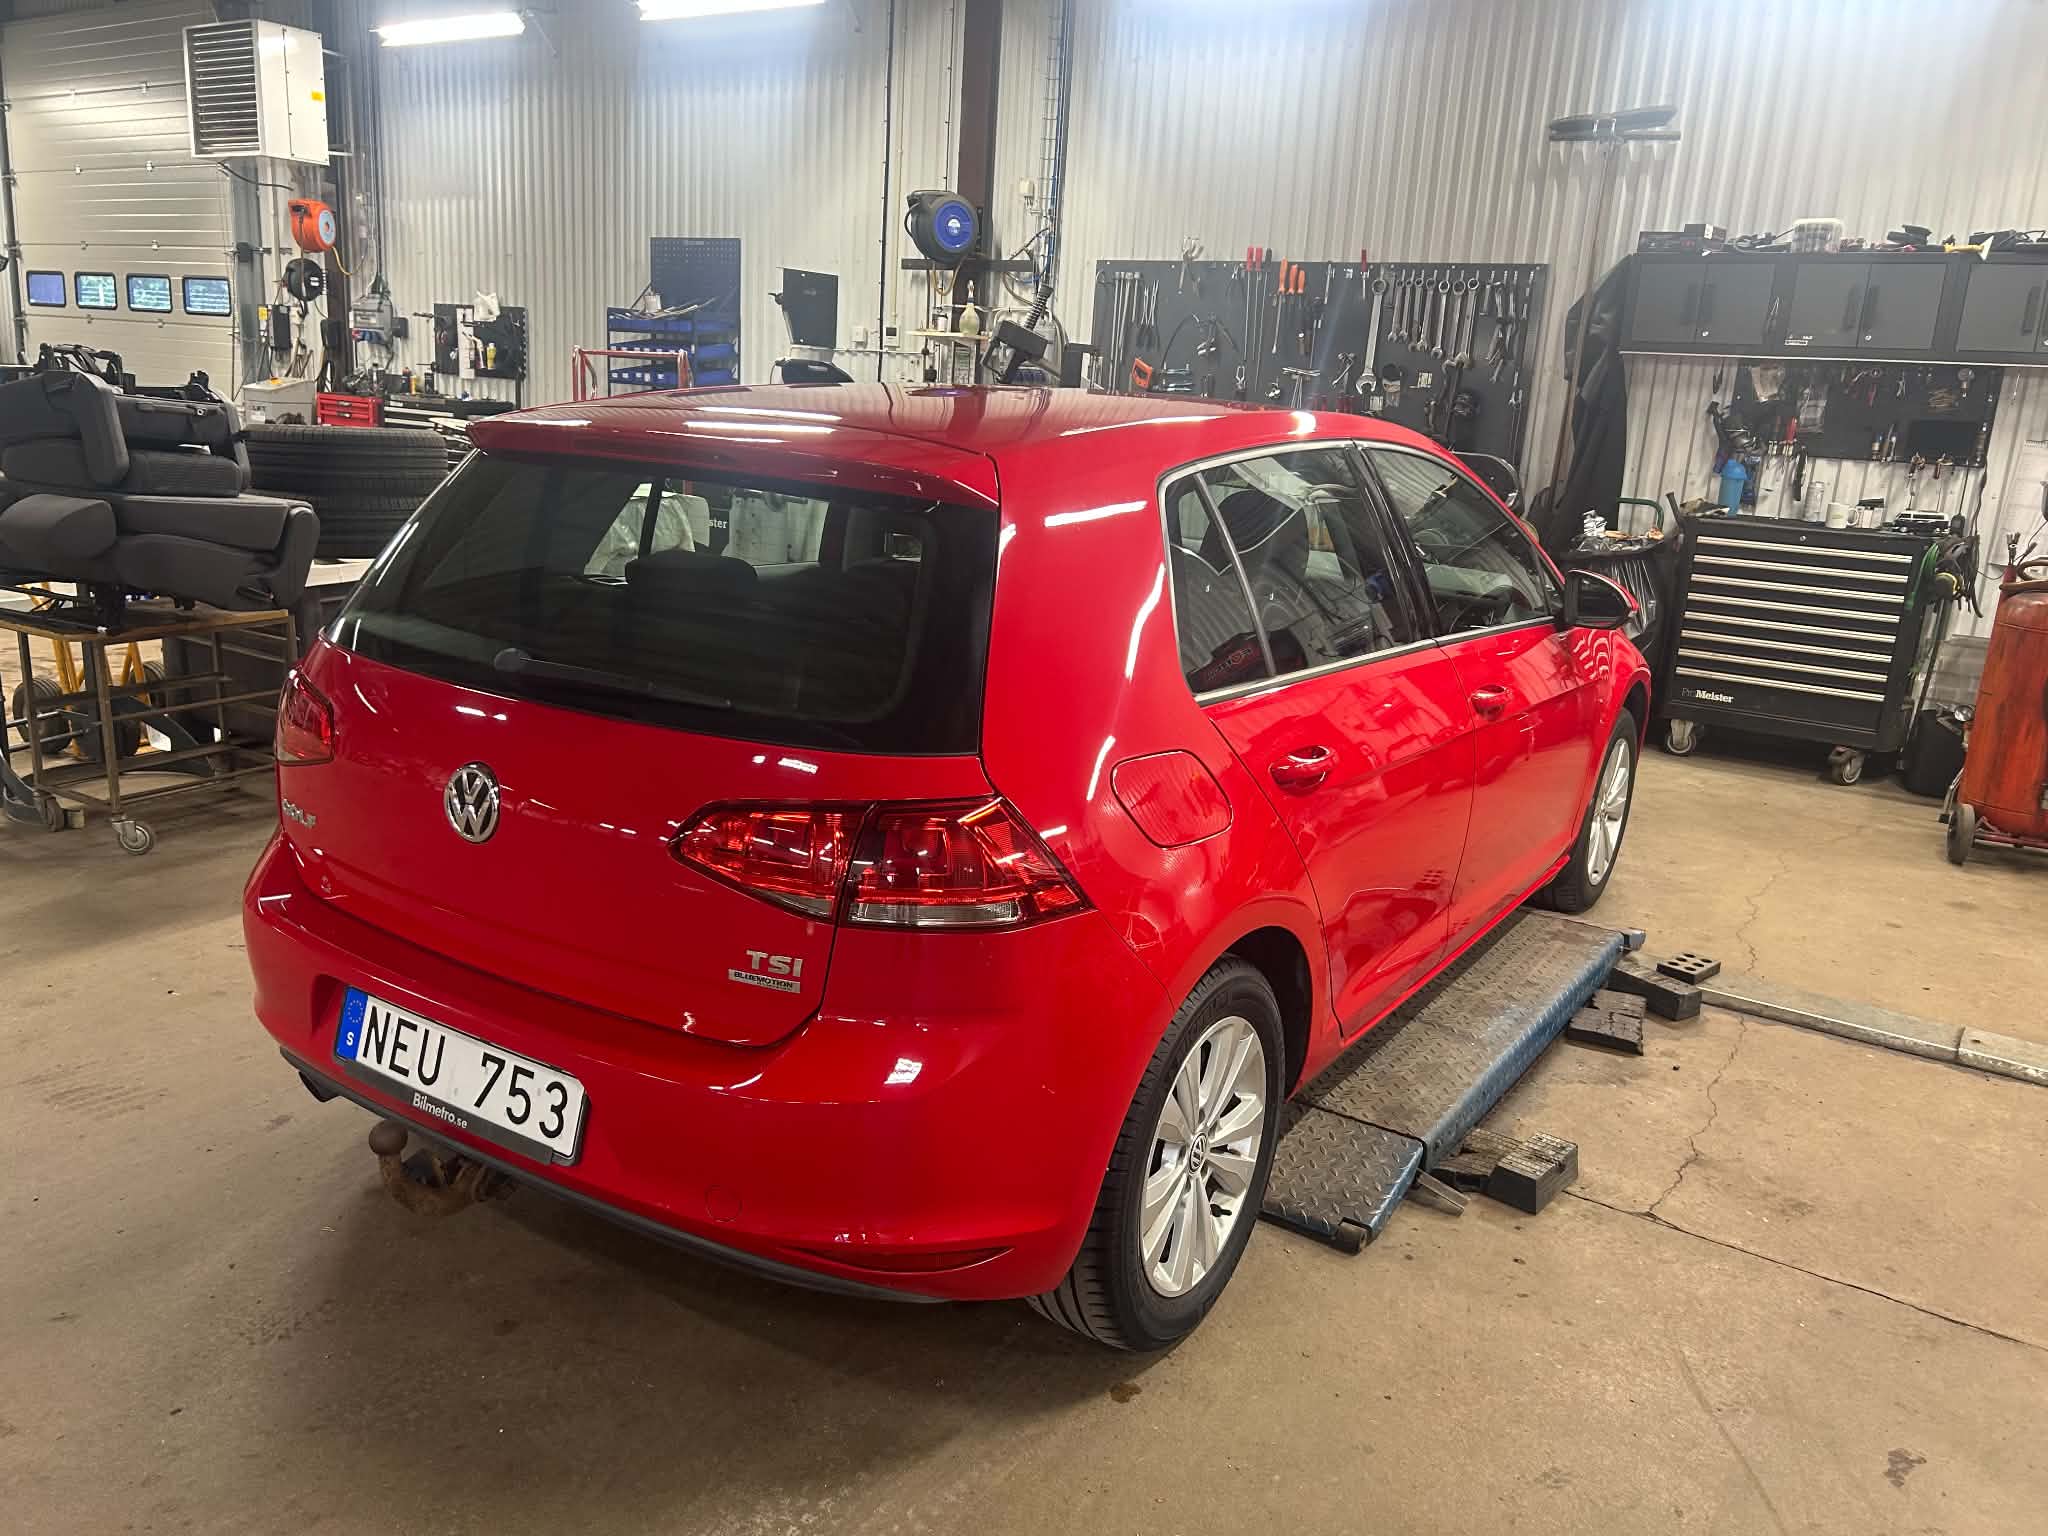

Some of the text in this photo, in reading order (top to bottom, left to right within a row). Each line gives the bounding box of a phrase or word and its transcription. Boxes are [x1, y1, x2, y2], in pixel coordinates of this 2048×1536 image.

[746, 949, 804, 978] TSI
[733, 971, 794, 989] BLUEMOTION
[346, 1031, 355, 1046] S
[362, 1005, 568, 1139] NEU 753
[412, 1092, 468, 1129] Bilmetro.se
